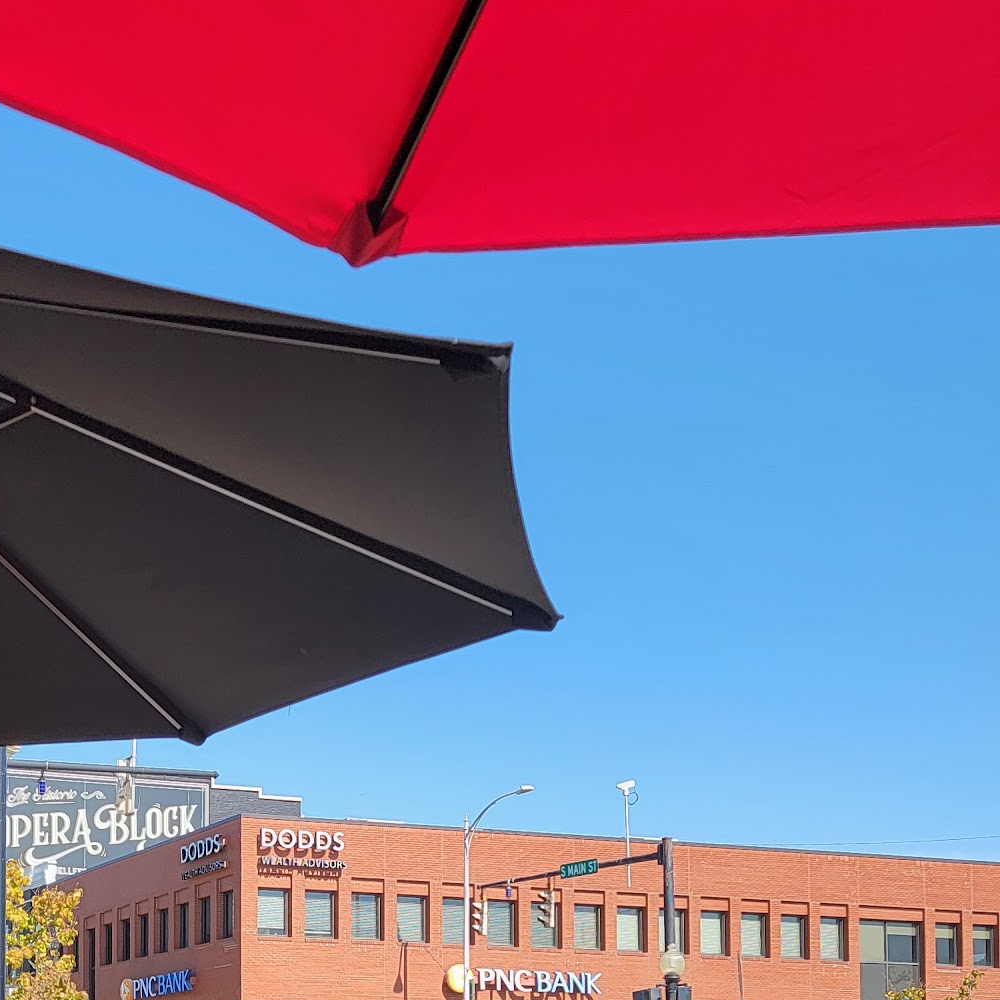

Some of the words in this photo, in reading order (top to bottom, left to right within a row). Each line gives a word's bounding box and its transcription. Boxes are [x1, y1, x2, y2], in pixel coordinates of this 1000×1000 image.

[6, 785, 31, 807] The
[5, 808, 93, 848] PERA
[94, 803, 198, 844] BLOCK
[180, 833, 221, 864] DODDS
[260, 828, 345, 852] DODDS
[261, 856, 301, 867] WEALTH
[301, 858, 347, 870] ADVISORS
[561, 866, 567, 878] S
[567, 863, 587, 876] MAIN
[588, 860, 598, 873] ST
